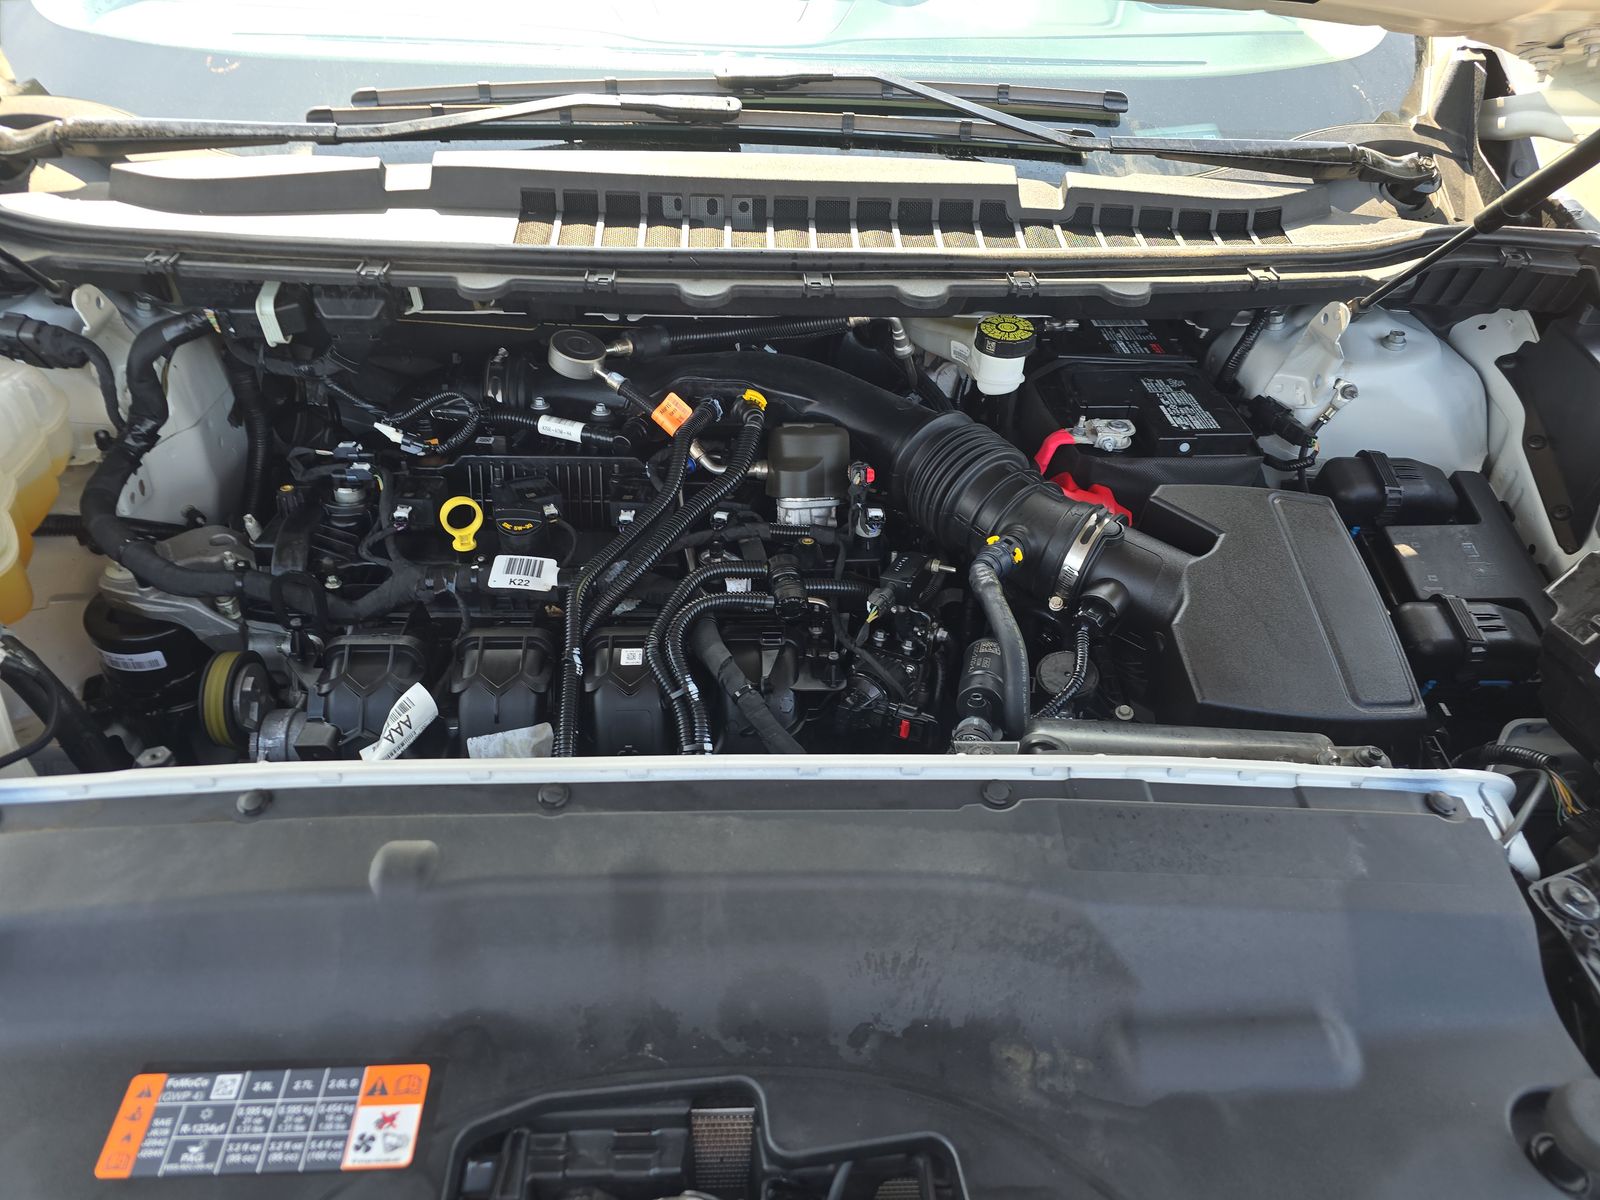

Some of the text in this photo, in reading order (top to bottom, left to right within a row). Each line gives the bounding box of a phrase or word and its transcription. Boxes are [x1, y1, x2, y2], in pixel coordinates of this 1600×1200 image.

[509, 578, 530, 586] K22
[384, 714, 412, 744] AAA
[166, 1077, 210, 1087] FoMoCo
[159, 1091, 204, 1101] (GWP 4)
[180, 1123, 226, 1134] R-1234yf
[180, 1152, 205, 1162] PAG
